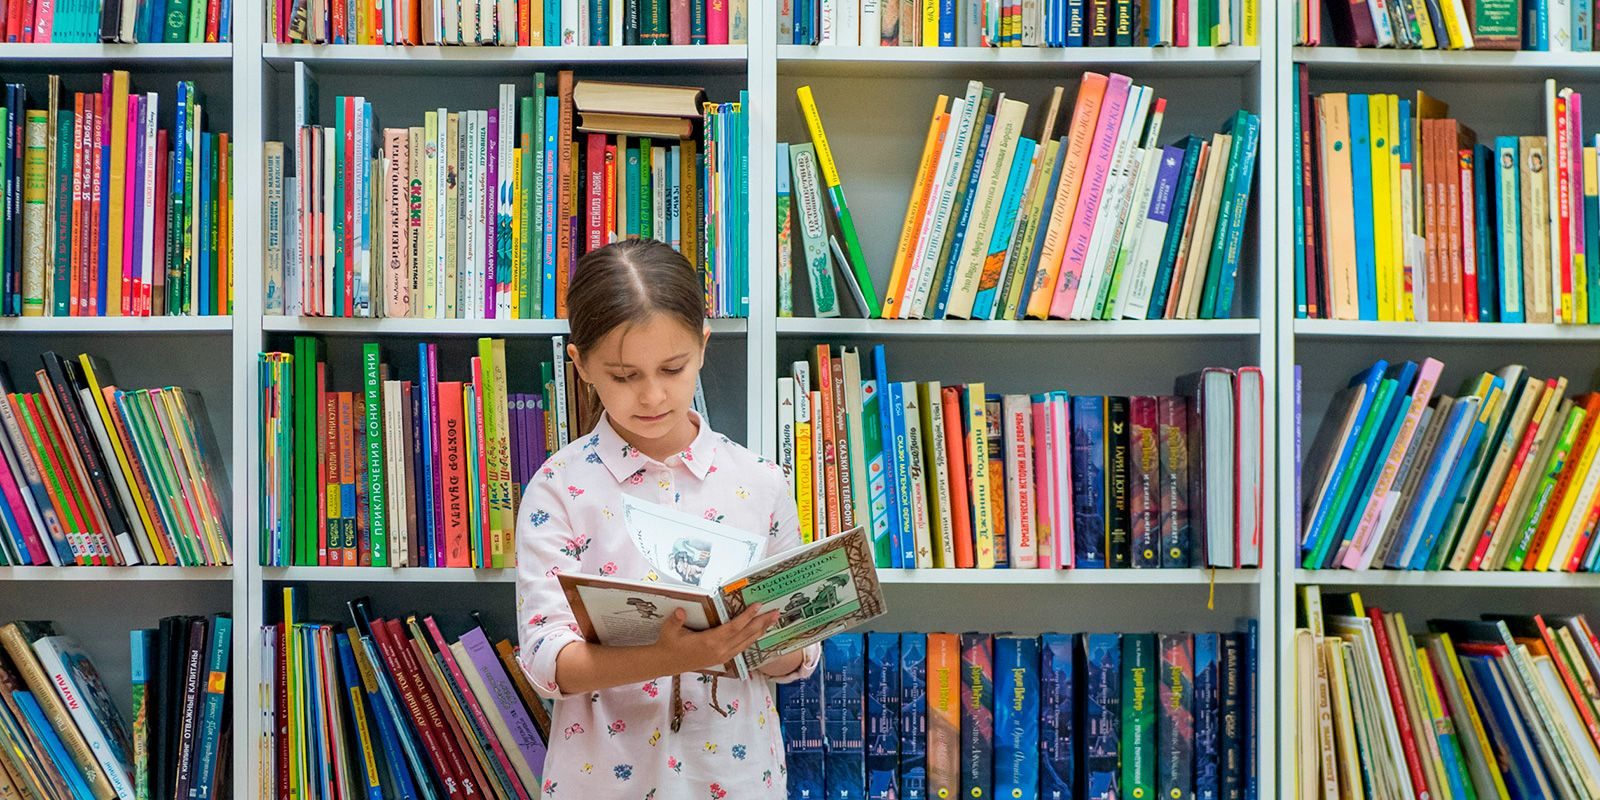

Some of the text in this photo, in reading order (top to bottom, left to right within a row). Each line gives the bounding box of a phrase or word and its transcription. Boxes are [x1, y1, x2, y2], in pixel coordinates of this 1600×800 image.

[1068, 9, 1081, 37] Гарри
[1093, 7, 1107, 36] Гарри
[1117, 7, 1129, 35] Гарри
[73, 113, 82, 149] Спать!
[84, 110, 92, 146] Люблю!
[1066, 98, 1094, 157] книжки
[73, 173, 81, 200] Пора
[592, 171, 601, 227] СТЕЙПЛЗ ЛЬЮИС
[918, 266, 931, 293] Распэ
[927, 190, 952, 260] ПРИКЛЮЧЕНИЯ
[946, 161, 959, 187] барона
[954, 94, 977, 158] МЮНХАУЗЕНА
[1069, 101, 1121, 265] Мои любимые книжки
[1560, 179, 1568, 218] СКАЗКИ
[411, 179, 423, 227] СКАЗКИ
[560, 173, 569, 249] ПУТЕШЕСТВИЕ
[1041, 161, 1077, 260] Мои любимые
[1168, 207, 1185, 262] ПУТЕШЕСТВИЕ
[367, 353, 377, 385] ВАНИ
[328, 399, 336, 439] КАНИКУЛАХ
[369, 403, 379, 436] СОНИ
[799, 428, 808, 455] КОТЫ
[838, 440, 847, 470] СКАЗКИ
[896, 435, 905, 462] СКАЗКИ
[328, 451, 337, 479] ТРОЛЛИ
[447, 419, 460, 528] ДОКТОР ДУЛИТЛ
[800, 458, 809, 497] ГОРОДА
[826, 466, 835, 497] СКАЗКИ
[841, 471, 849, 482] ПО
[898, 463, 908, 505] МАЛЕНЬКОЙ
[975, 428, 989, 539] Джанни Родари
[1015, 412, 1030, 547] Романтические истории для девочек
[371, 442, 383, 535] ПРИКЛЮЧЕНИЯ
[843, 485, 853, 526] ТЕЛЕФОНУ
[801, 499, 810, 527] РИМА
[901, 507, 910, 533] ФЕРМЫ
[939, 479, 952, 553] ДЖАННИ РОДАРИ
[747, 553, 840, 594] МЕДВЕЖОНОК
[775, 566, 825, 589] ГОСТЯХ
[187, 649, 199, 692] КАПИТАНЫ
[411, 671, 427, 692] ТОМ
[1012, 668, 1025, 687] Гарри
[1130, 668, 1146, 711] Гарри Поттер
[183, 694, 195, 738] ОТВАЖНЫЕ
[394, 670, 428, 728] ЛУННЫЙ ТОМ
[420, 691, 445, 730] ЛУННЫЙ
[1014, 687, 1026, 711] Поттер
[182, 742, 190, 772] КИПЛИНГ
